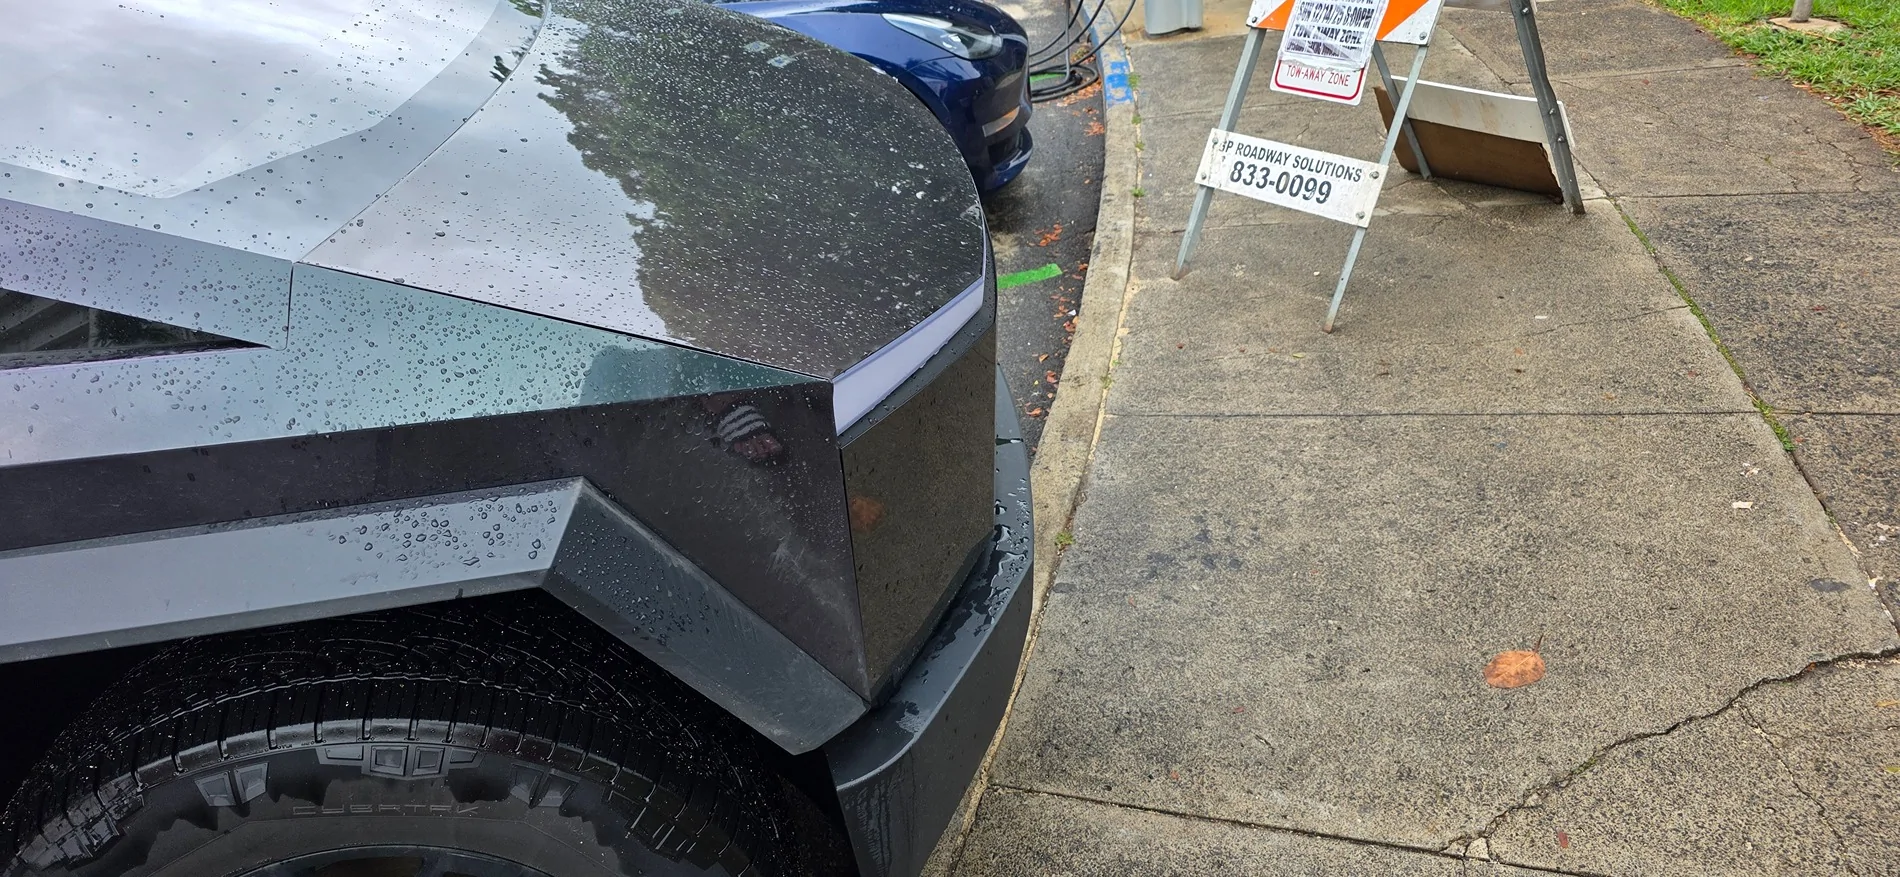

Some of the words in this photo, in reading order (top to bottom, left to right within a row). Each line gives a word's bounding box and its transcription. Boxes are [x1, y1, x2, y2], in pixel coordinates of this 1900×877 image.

[1287, 65, 1326, 82] TOW-AWAY
[1327, 71, 1351, 87] ZONE
[1229, 160, 1332, 204] 833-0099
[1235, 143, 1291, 166] ROADWAY
[1292, 155, 1363, 183] SOLUTIONS
